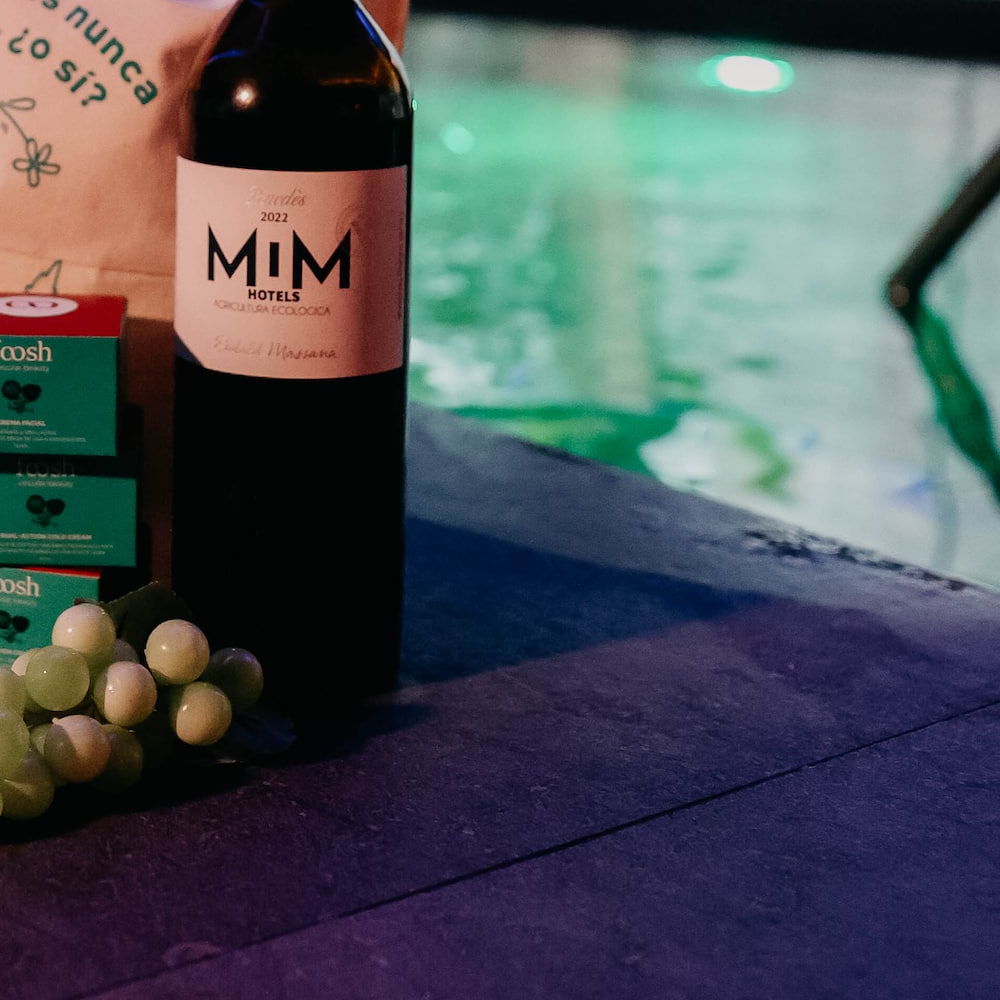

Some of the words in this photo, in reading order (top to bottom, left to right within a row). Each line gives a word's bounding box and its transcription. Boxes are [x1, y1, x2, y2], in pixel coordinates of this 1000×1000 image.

[7, 27, 51, 60] ¿o
[54, 59, 108, 107] sí?
[64, 4, 159, 105] nunca
[260, 211, 289, 223] 2022
[247, 289, 301, 302] HOTELS
